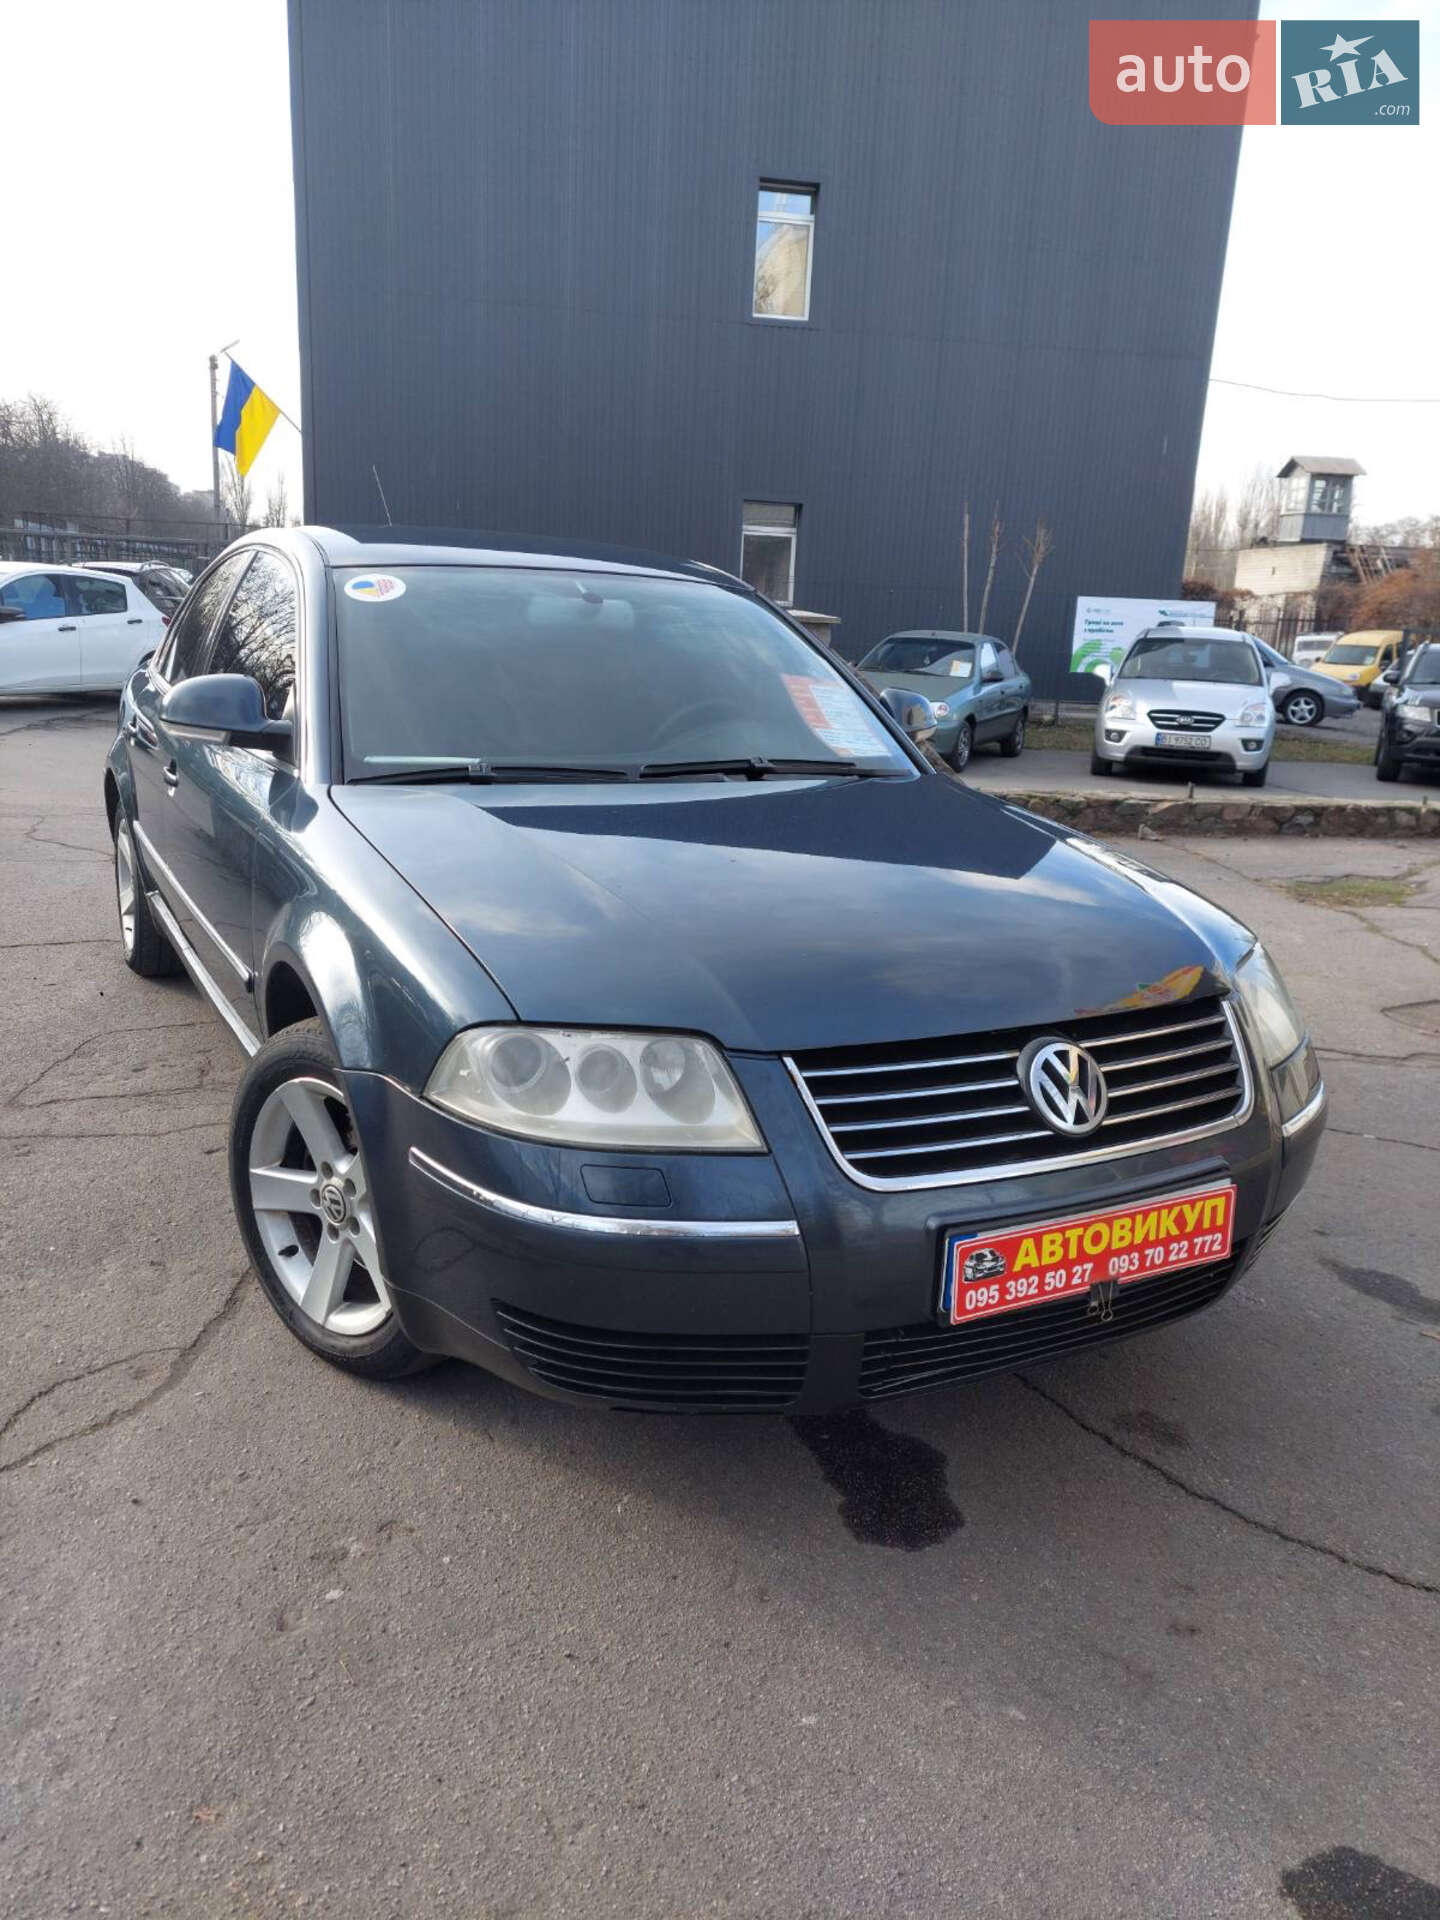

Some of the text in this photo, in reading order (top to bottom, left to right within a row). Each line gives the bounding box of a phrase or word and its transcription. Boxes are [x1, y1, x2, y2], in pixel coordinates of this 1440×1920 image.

[965, 1232, 1223, 1310] 095 392 50 27 093 70 22 772
[1012, 1196, 1226, 1272] АВТОВИКУП
